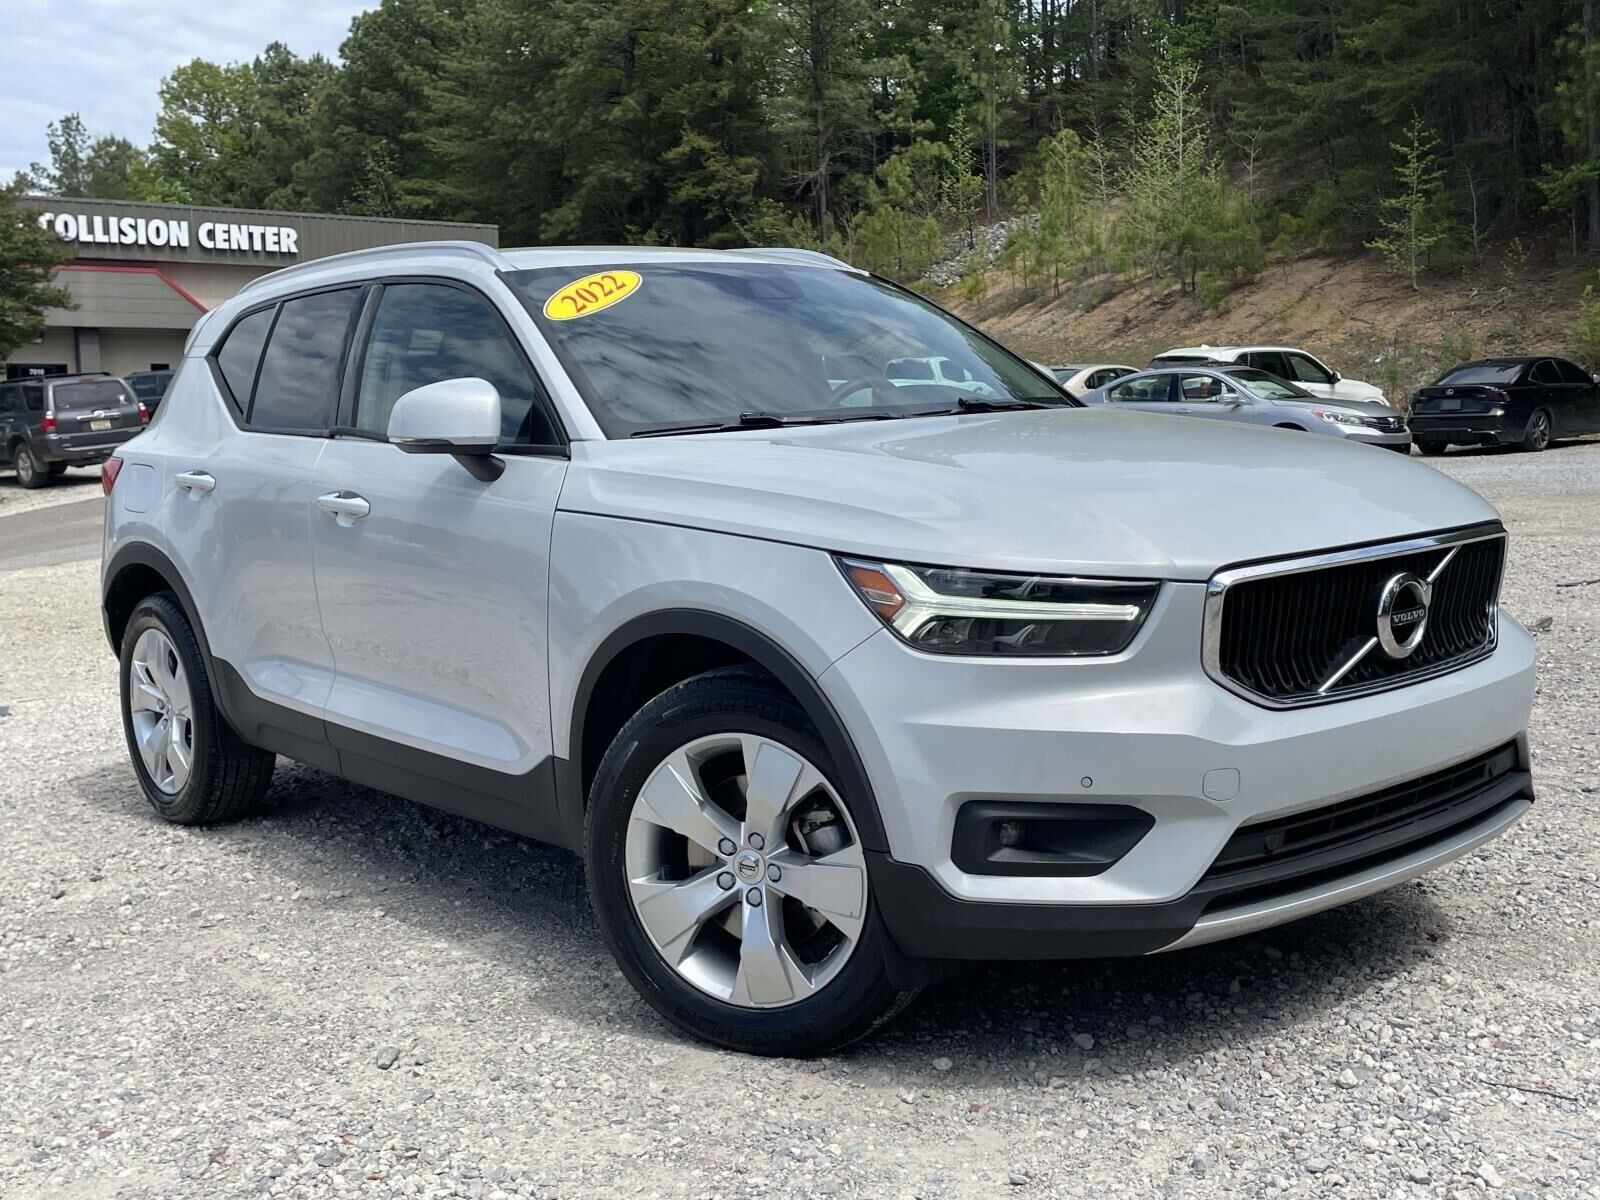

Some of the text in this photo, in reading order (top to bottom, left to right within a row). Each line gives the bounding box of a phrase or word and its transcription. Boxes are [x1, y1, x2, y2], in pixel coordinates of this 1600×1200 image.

[198, 222, 298, 253] CENTER
[561, 275, 626, 313] 2022
[1392, 609, 1425, 623] VOLVO
